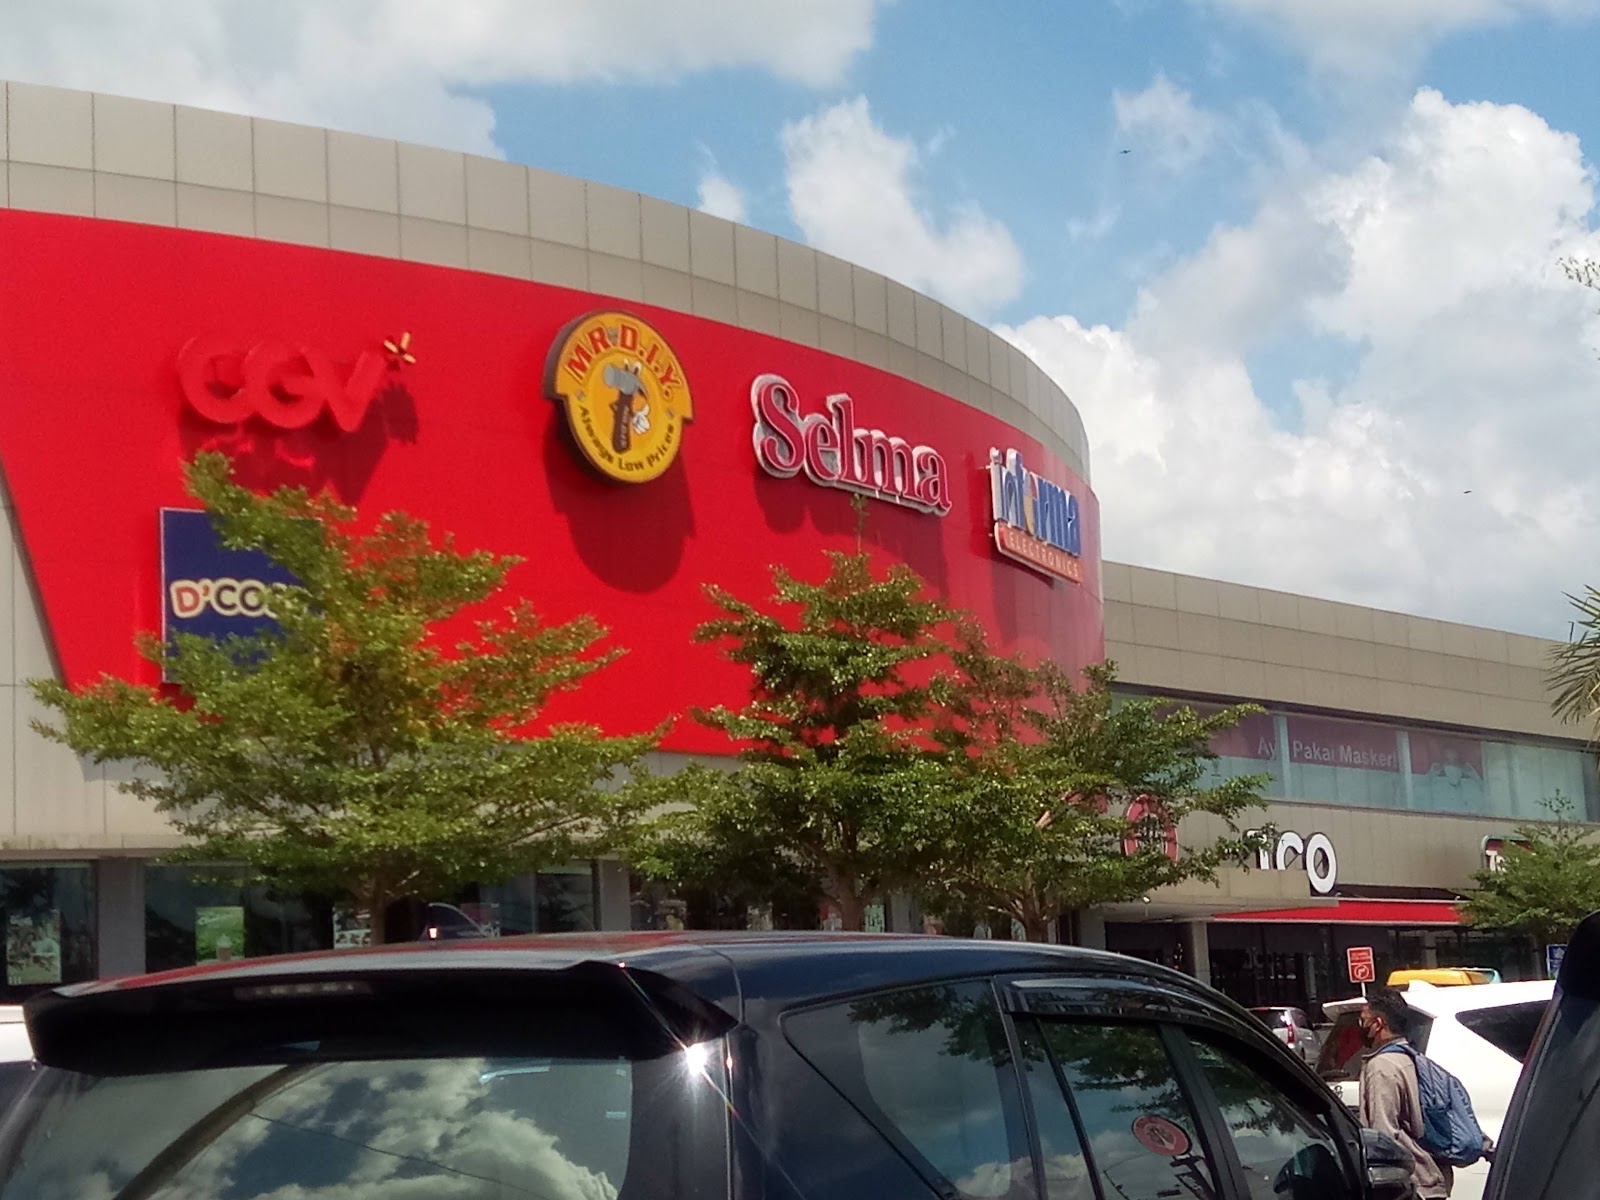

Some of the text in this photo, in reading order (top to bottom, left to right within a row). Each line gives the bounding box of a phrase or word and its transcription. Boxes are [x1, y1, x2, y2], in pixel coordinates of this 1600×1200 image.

[176, 336, 386, 433] CGV
[617, 456, 645, 472] Low
[754, 376, 953, 513] Selma
[1008, 531, 1079, 579] ELECTRONICS
[1292, 740, 1335, 762] Pakai
